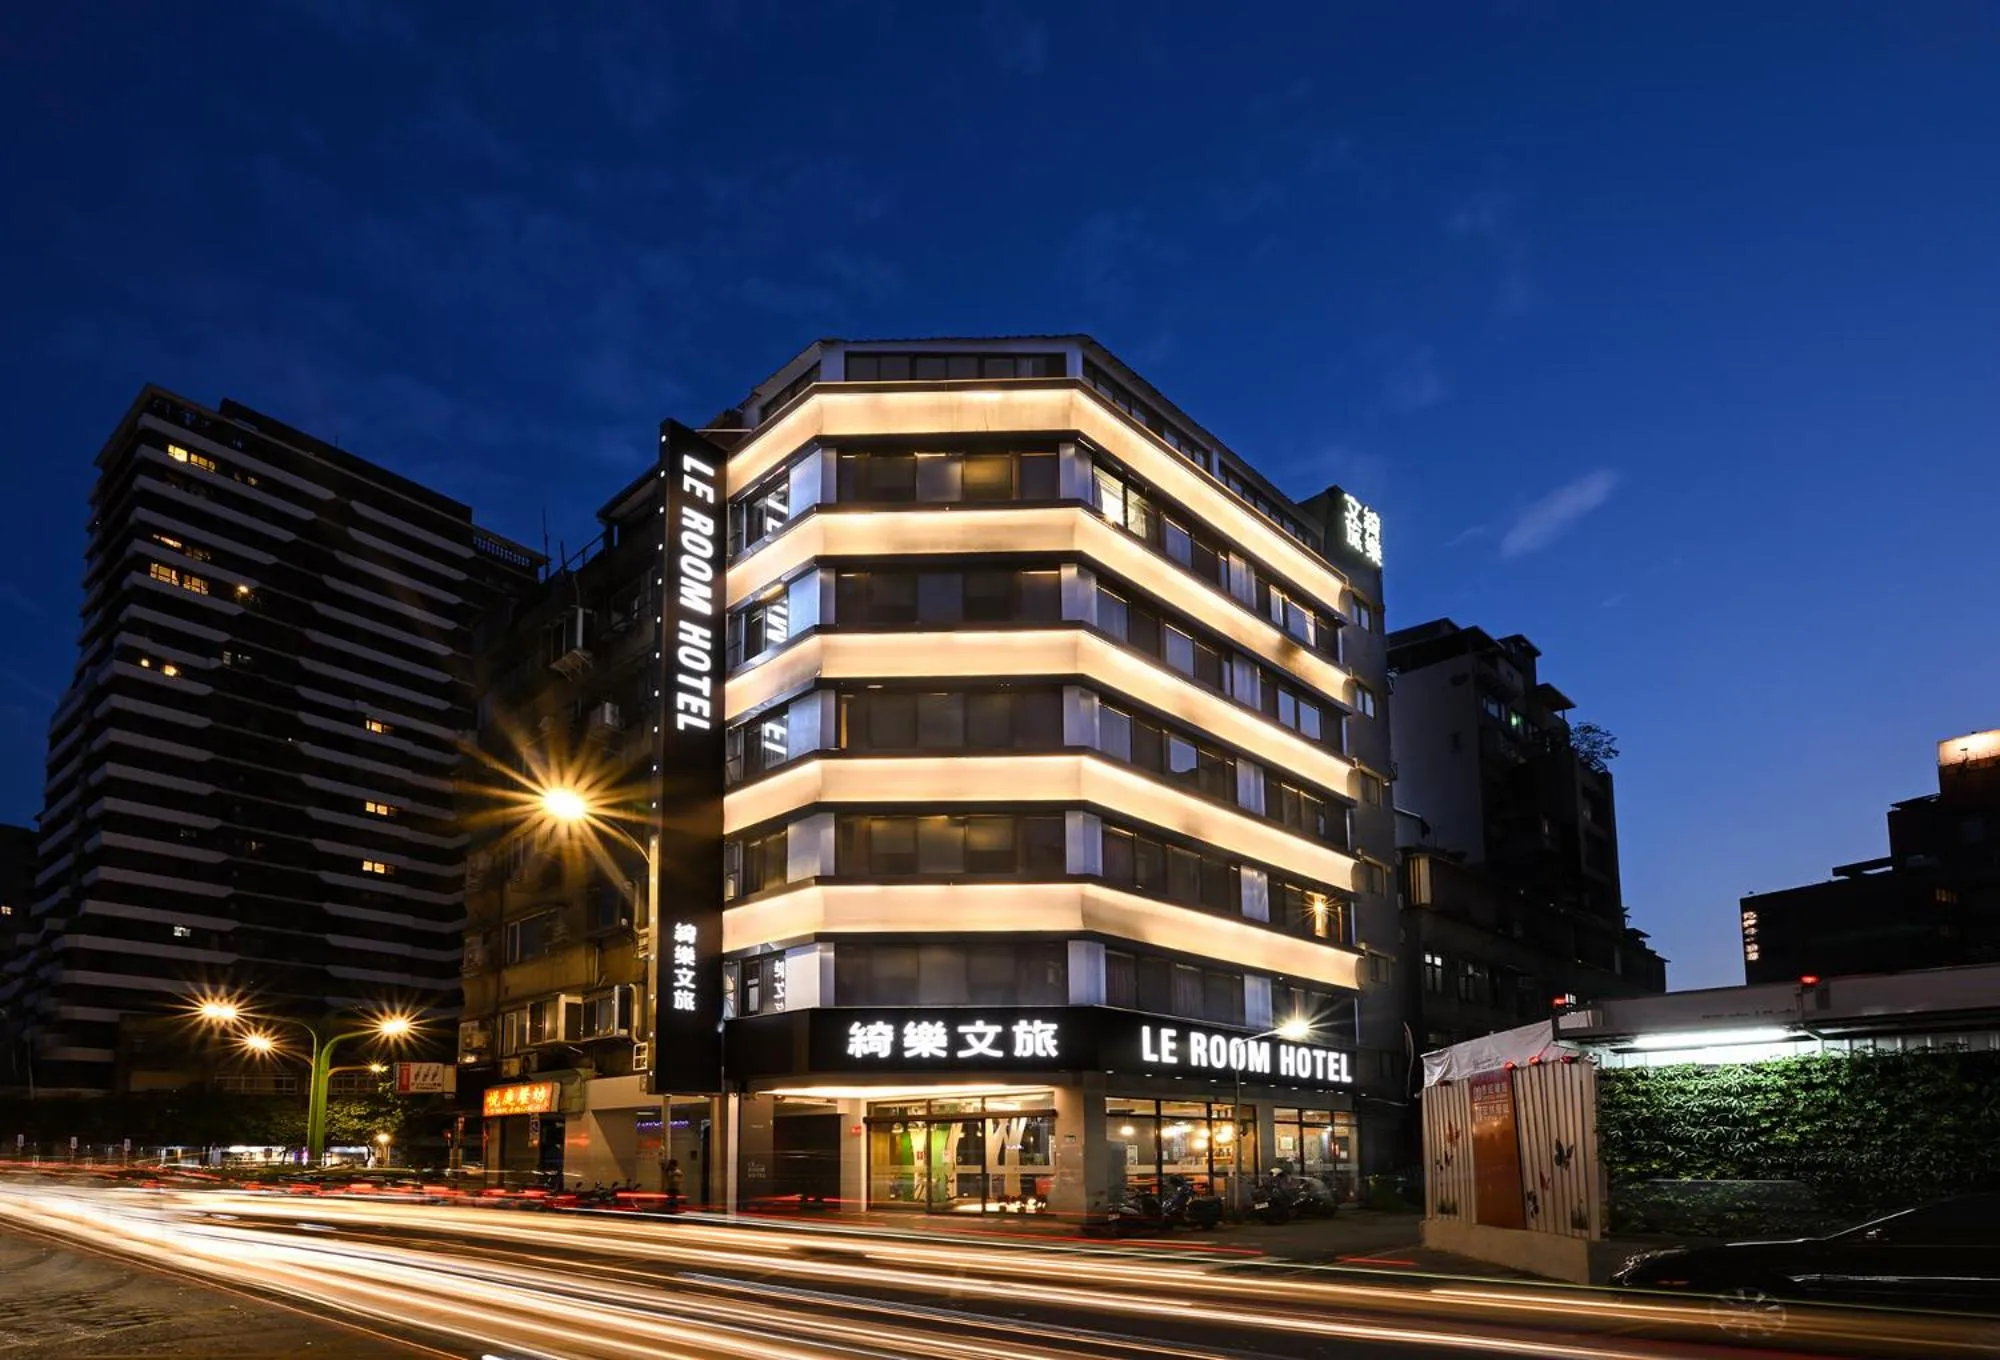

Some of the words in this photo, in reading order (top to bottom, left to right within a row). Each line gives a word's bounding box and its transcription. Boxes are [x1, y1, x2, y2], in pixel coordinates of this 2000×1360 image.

[681, 453, 716, 504] LE
[679, 506, 715, 616] ROOM
[676, 619, 713, 732] HOTEL
[846, 1019, 1059, 1058] 綺樂文旅
[1141, 1024, 1180, 1064] LE
[1189, 1030, 1271, 1075] ROOM
[1278, 1044, 1354, 1084] HOTEL
